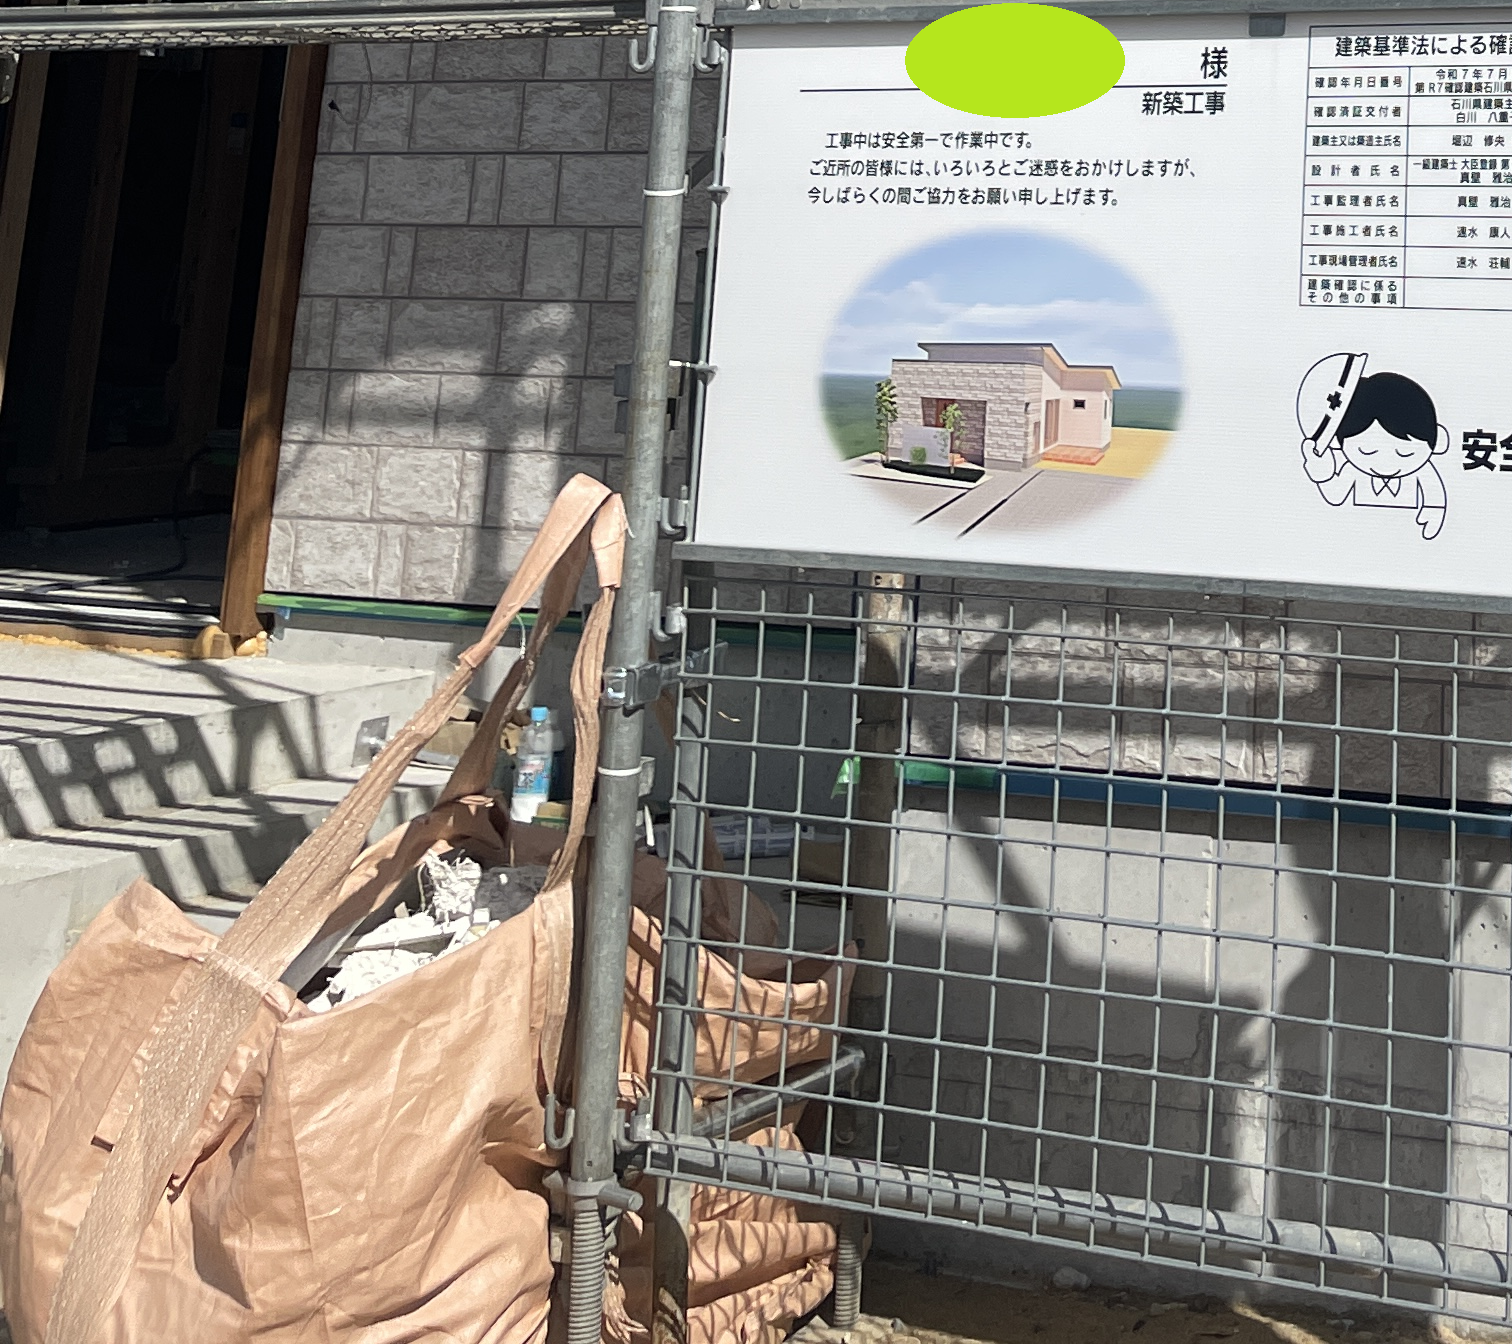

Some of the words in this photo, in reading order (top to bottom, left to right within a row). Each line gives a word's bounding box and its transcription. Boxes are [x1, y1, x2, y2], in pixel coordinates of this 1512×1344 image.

[1201, 47, 1228, 79] 様
[1315, 76, 1402, 88] 確認年月日番号
[1142, 91, 1225, 115] 新築工事
[1314, 106, 1401, 117] 確認済証交付者
[825, 131, 1031, 149] 工事中は安全第一で作業中です。
[810, 158, 1195, 177] ご近所の皆様には、いろいろとご迷惑をおかけしますが、
[1312, 165, 1399, 176] 設計者氏名
[808, 187, 1117, 206] 今しばらくの間ご協力をお願い申し上げます。
[1311, 195, 1398, 207] 工事監理者氏名
[1310, 225, 1398, 237] 工事施工者氏名
[1309, 255, 1397, 267] 工事現場管理者氏名
[1308, 277, 1399, 291] 建築確認に係る
[1308, 290, 1397, 304] その他の事項
